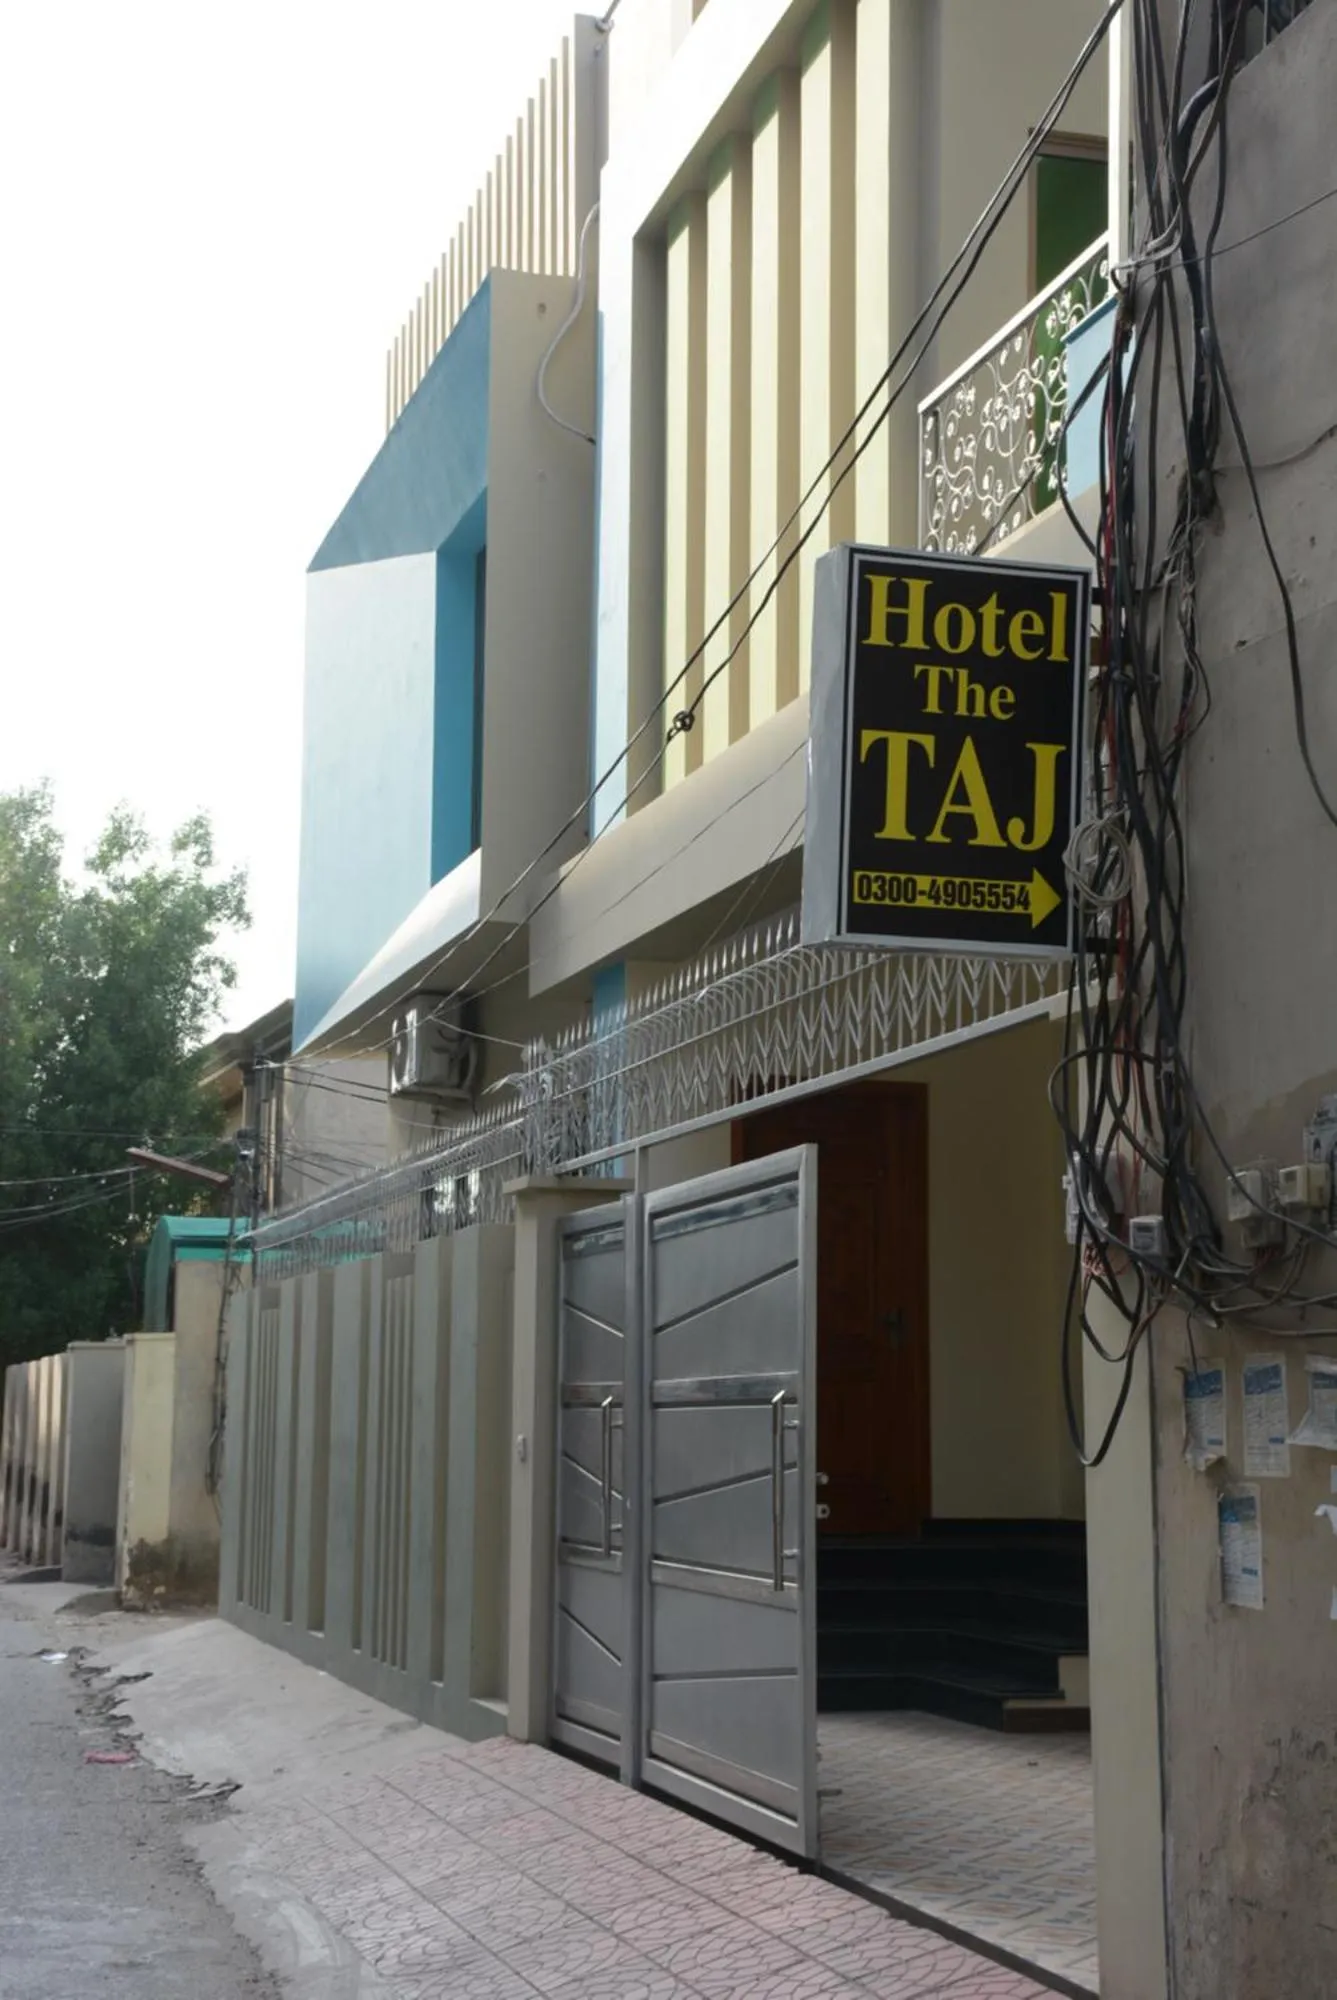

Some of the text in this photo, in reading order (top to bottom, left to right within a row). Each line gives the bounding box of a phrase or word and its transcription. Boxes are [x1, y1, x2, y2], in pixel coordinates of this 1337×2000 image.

[861, 574, 1070, 662] Hotel
[914, 664, 1016, 720] The
[859, 729, 1067, 852] TAJ
[857, 873, 1030, 911] 0300-4905554
